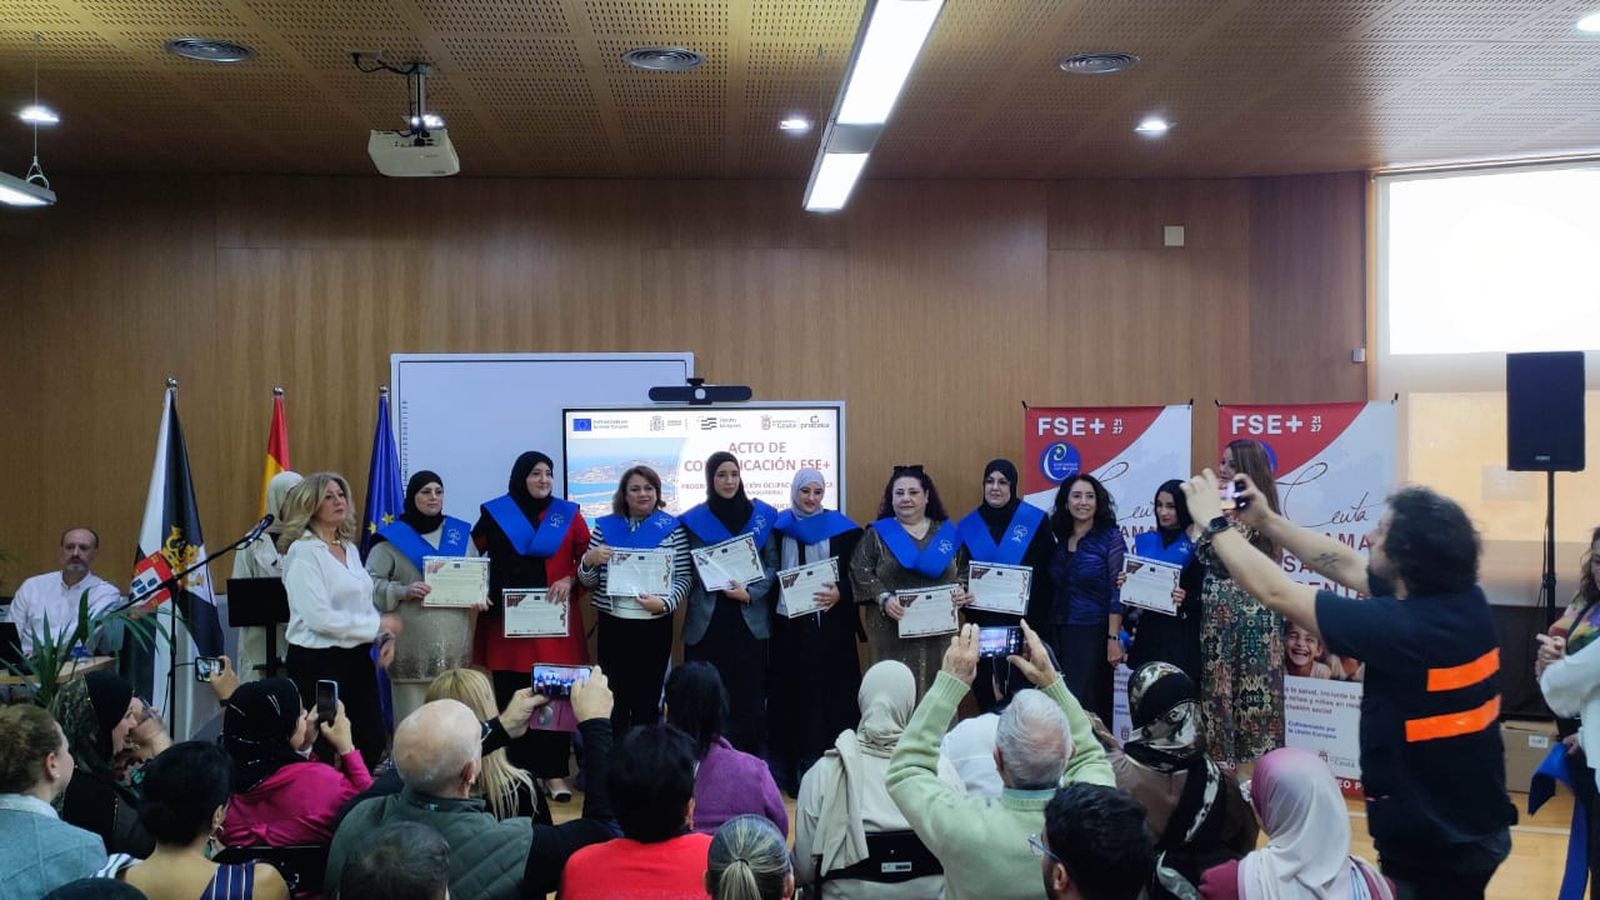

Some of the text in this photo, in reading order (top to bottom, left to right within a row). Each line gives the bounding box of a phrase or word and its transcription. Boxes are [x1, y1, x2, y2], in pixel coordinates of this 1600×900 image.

[1232, 414, 1304, 435] FSE+
[1311, 415, 1321, 423] 21
[1038, 417, 1105, 436] FSE+
[1111, 426, 1124, 434] 27
[1310, 424, 1322, 433] 27
[728, 441, 787, 454] ACTO DE
[684, 456, 796, 472] COICACIÓN
